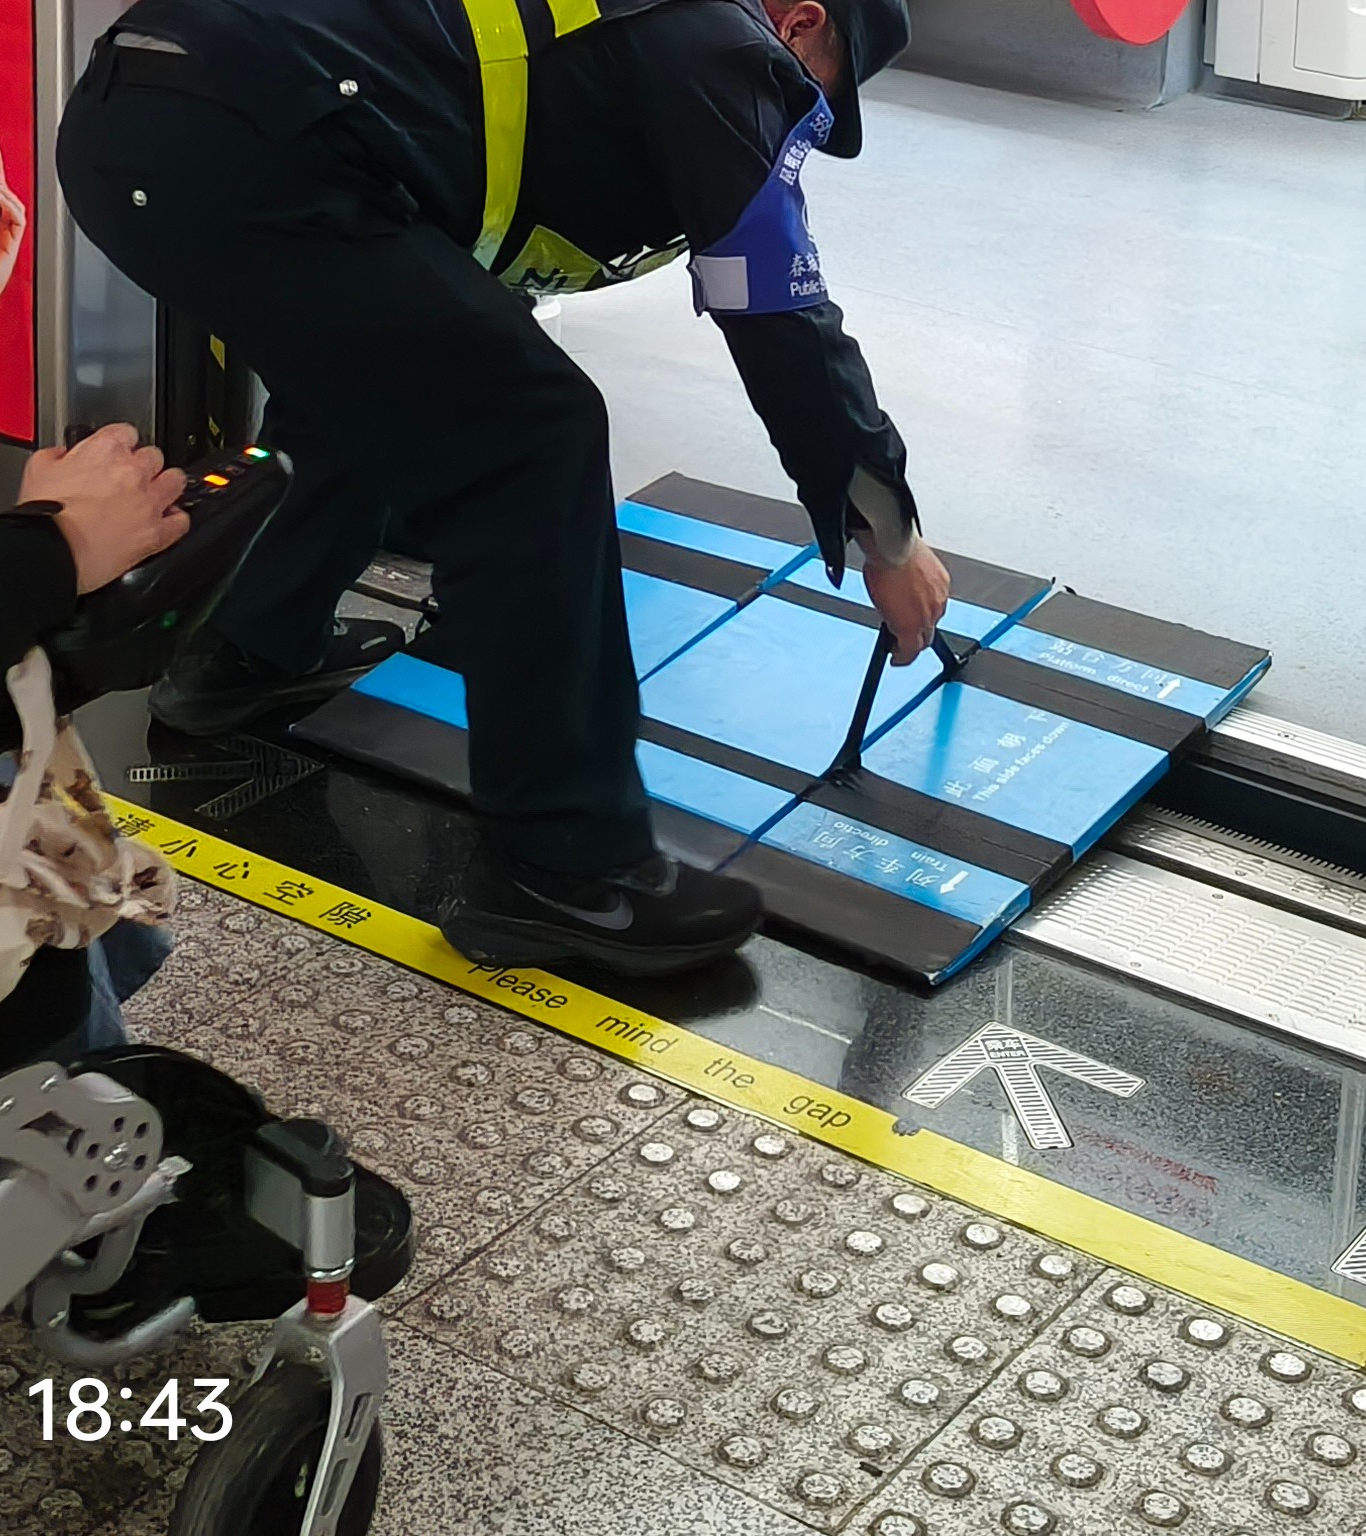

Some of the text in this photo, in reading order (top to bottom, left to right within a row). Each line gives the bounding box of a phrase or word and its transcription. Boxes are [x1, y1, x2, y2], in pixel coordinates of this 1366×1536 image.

[790, 279, 820, 298] Public
[1036, 650, 1099, 678] Platform
[910, 849, 950, 873] Train
[466, 961, 853, 1131] Please mind the gap
[988, 1049, 1028, 1060] ENTER
